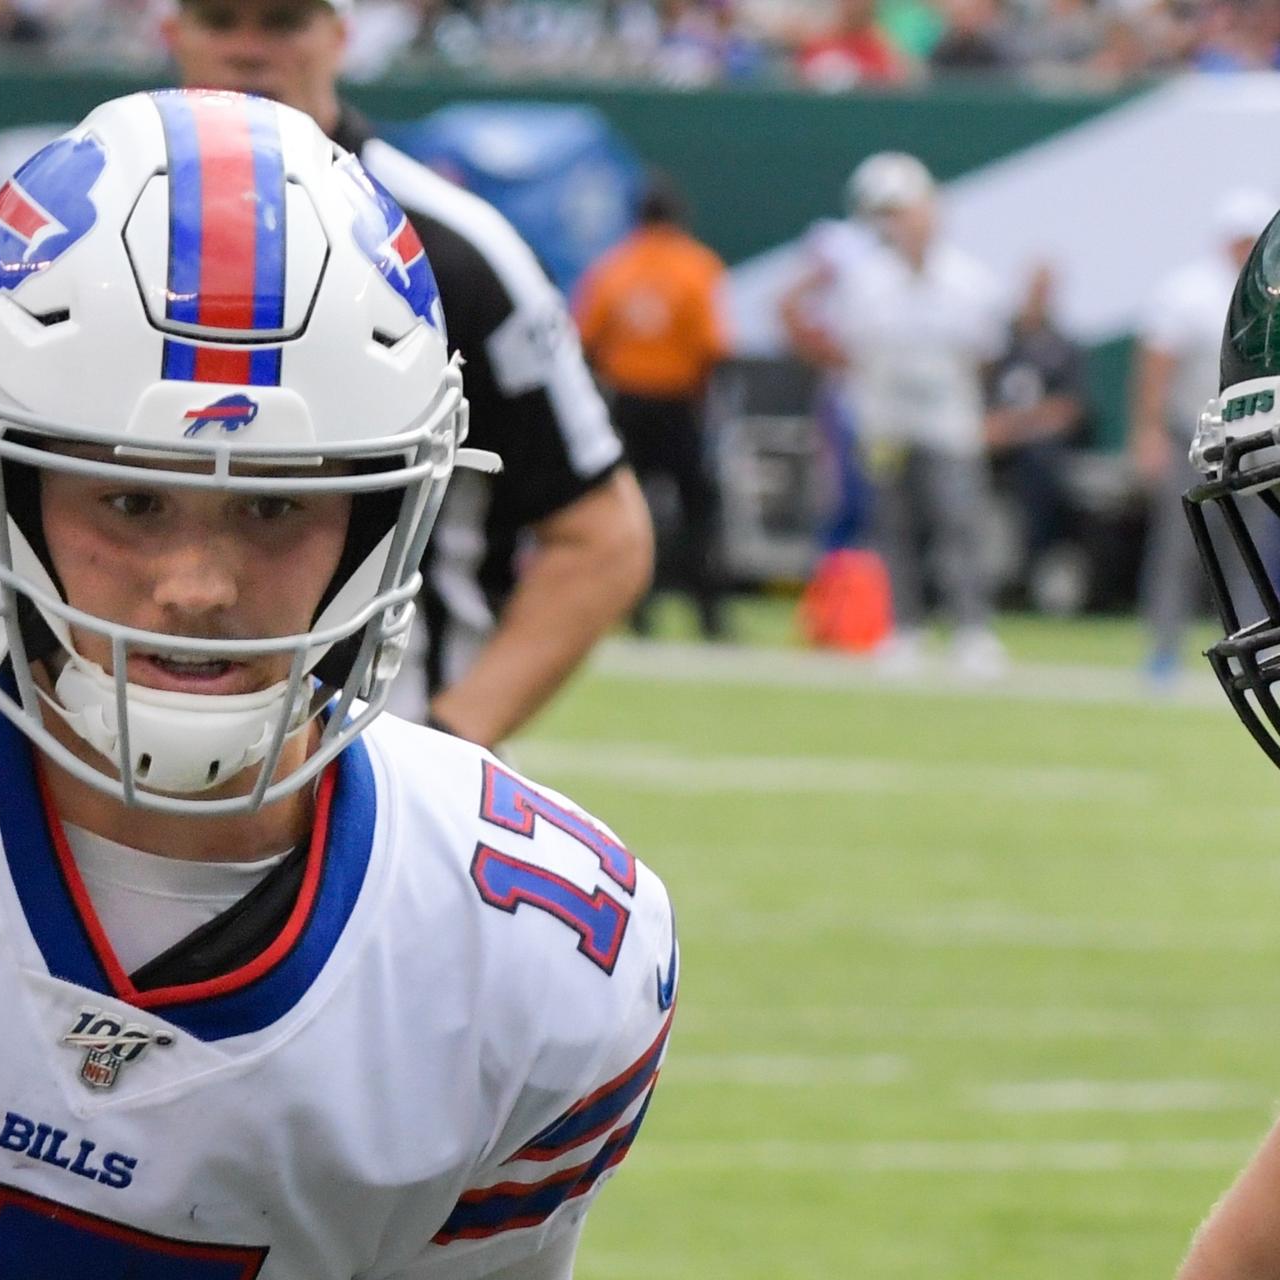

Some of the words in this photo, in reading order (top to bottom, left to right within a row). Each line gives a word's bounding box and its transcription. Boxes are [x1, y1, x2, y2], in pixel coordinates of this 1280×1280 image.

[469, 757, 637, 977] 17
[70, 1010, 150, 1062] 100
[82, 1063, 113, 1085] NFL
